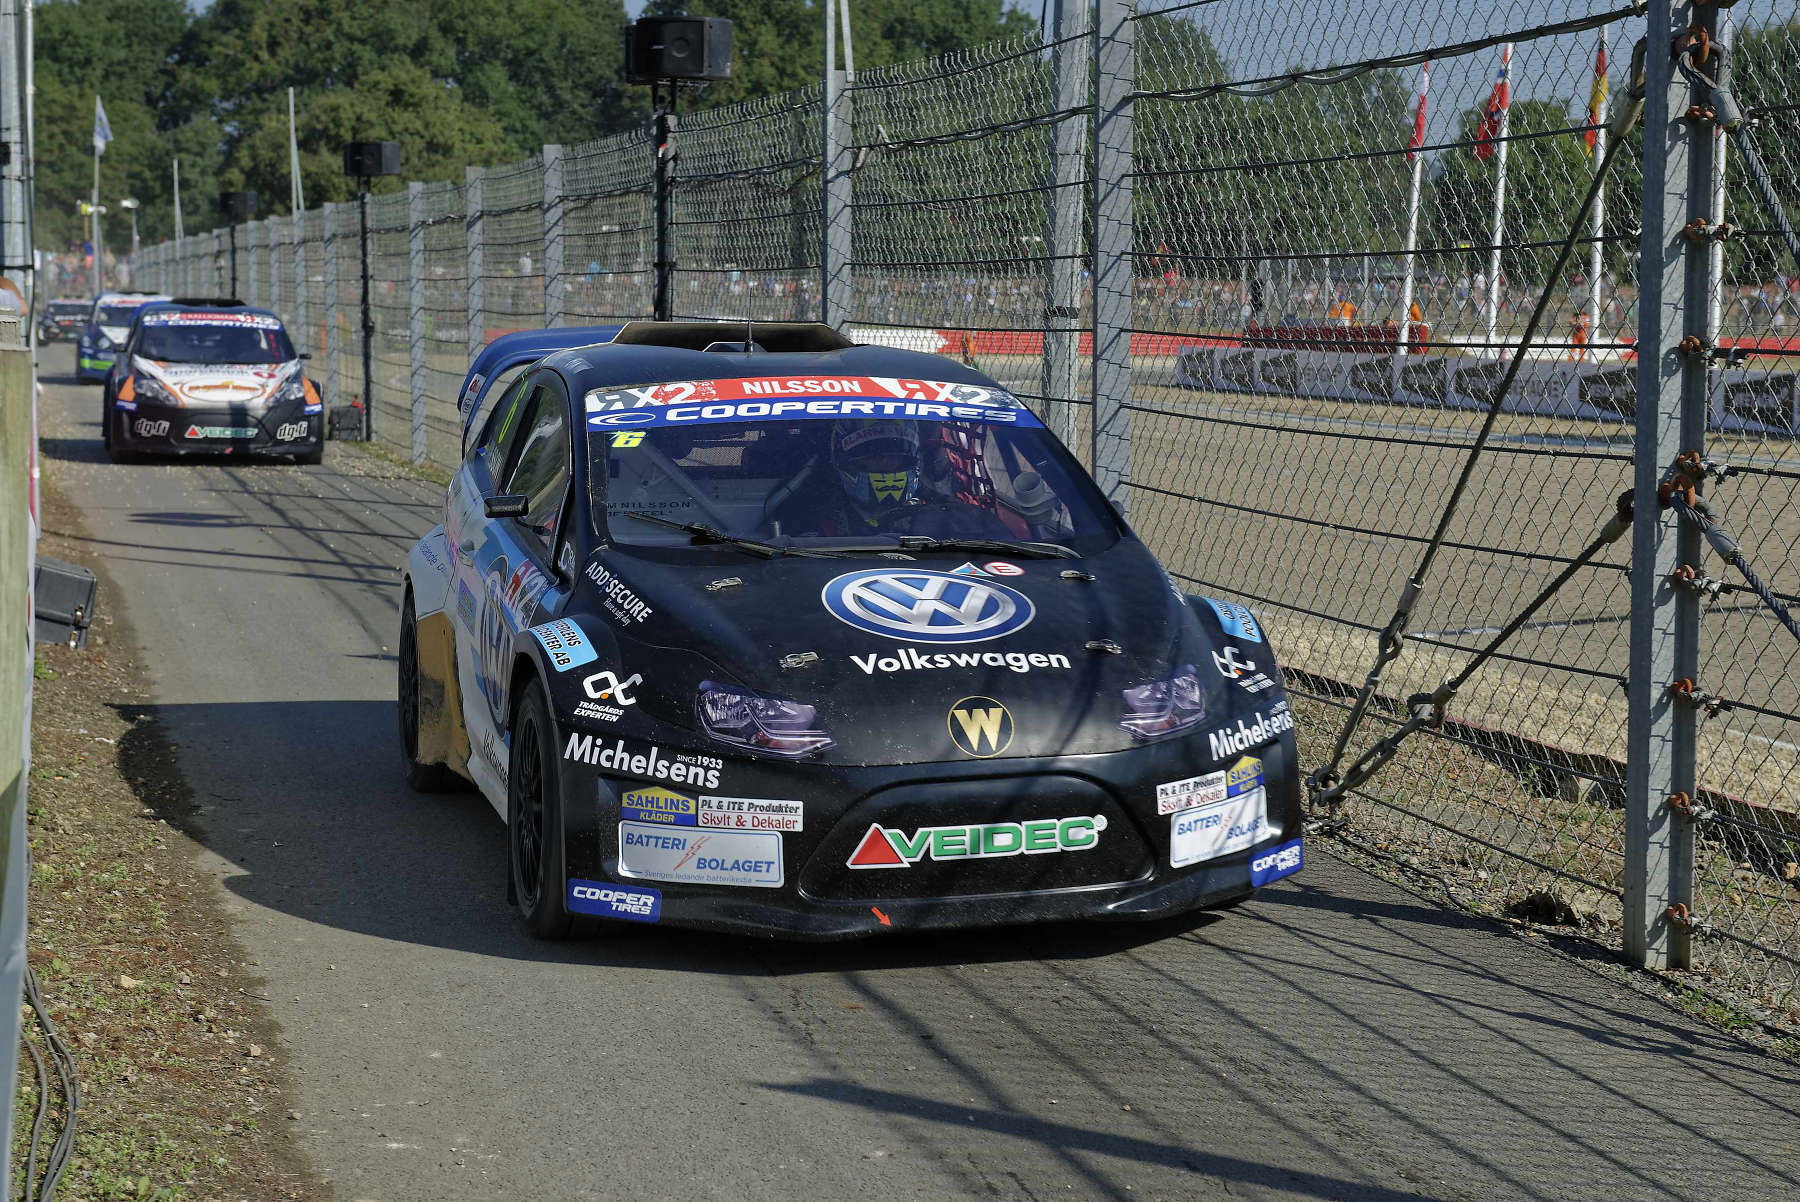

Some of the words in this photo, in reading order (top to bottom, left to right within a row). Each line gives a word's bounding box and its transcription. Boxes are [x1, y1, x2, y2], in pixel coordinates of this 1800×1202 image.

[742, 380, 862, 395] NILSSON
[611, 431, 646, 448] 6
[620, 501, 690, 509] NILSSON
[553, 651, 571, 666] AB
[850, 648, 1072, 675] Volkswagen
[573, 708, 619, 722] EXPERTEN
[952, 707, 1004, 752] W
[1208, 711, 1294, 761] Michelsens
[564, 732, 721, 789] Michelsens
[677, 754, 697, 764] SINCE
[697, 755, 723, 769] 1933
[626, 793, 690, 812] SAHLINS
[701, 800, 713, 809] PL
[716, 801, 724, 810] &
[727, 801, 744, 811] ITE
[747, 802, 800, 813] Produkter
[702, 812, 731, 826] Skylt
[736, 814, 747, 827] &
[752, 815, 798, 829] Dekaler
[1177, 814, 1223, 835] BATTERI
[1226, 816, 1264, 840] BOLAGET
[625, 832, 687, 851] BATTERI
[884, 816, 1099, 862] VEIDEC
[696, 857, 775, 873] BOLAGET
[573, 886, 655, 907] COOPER
[611, 902, 651, 915] TIRES
